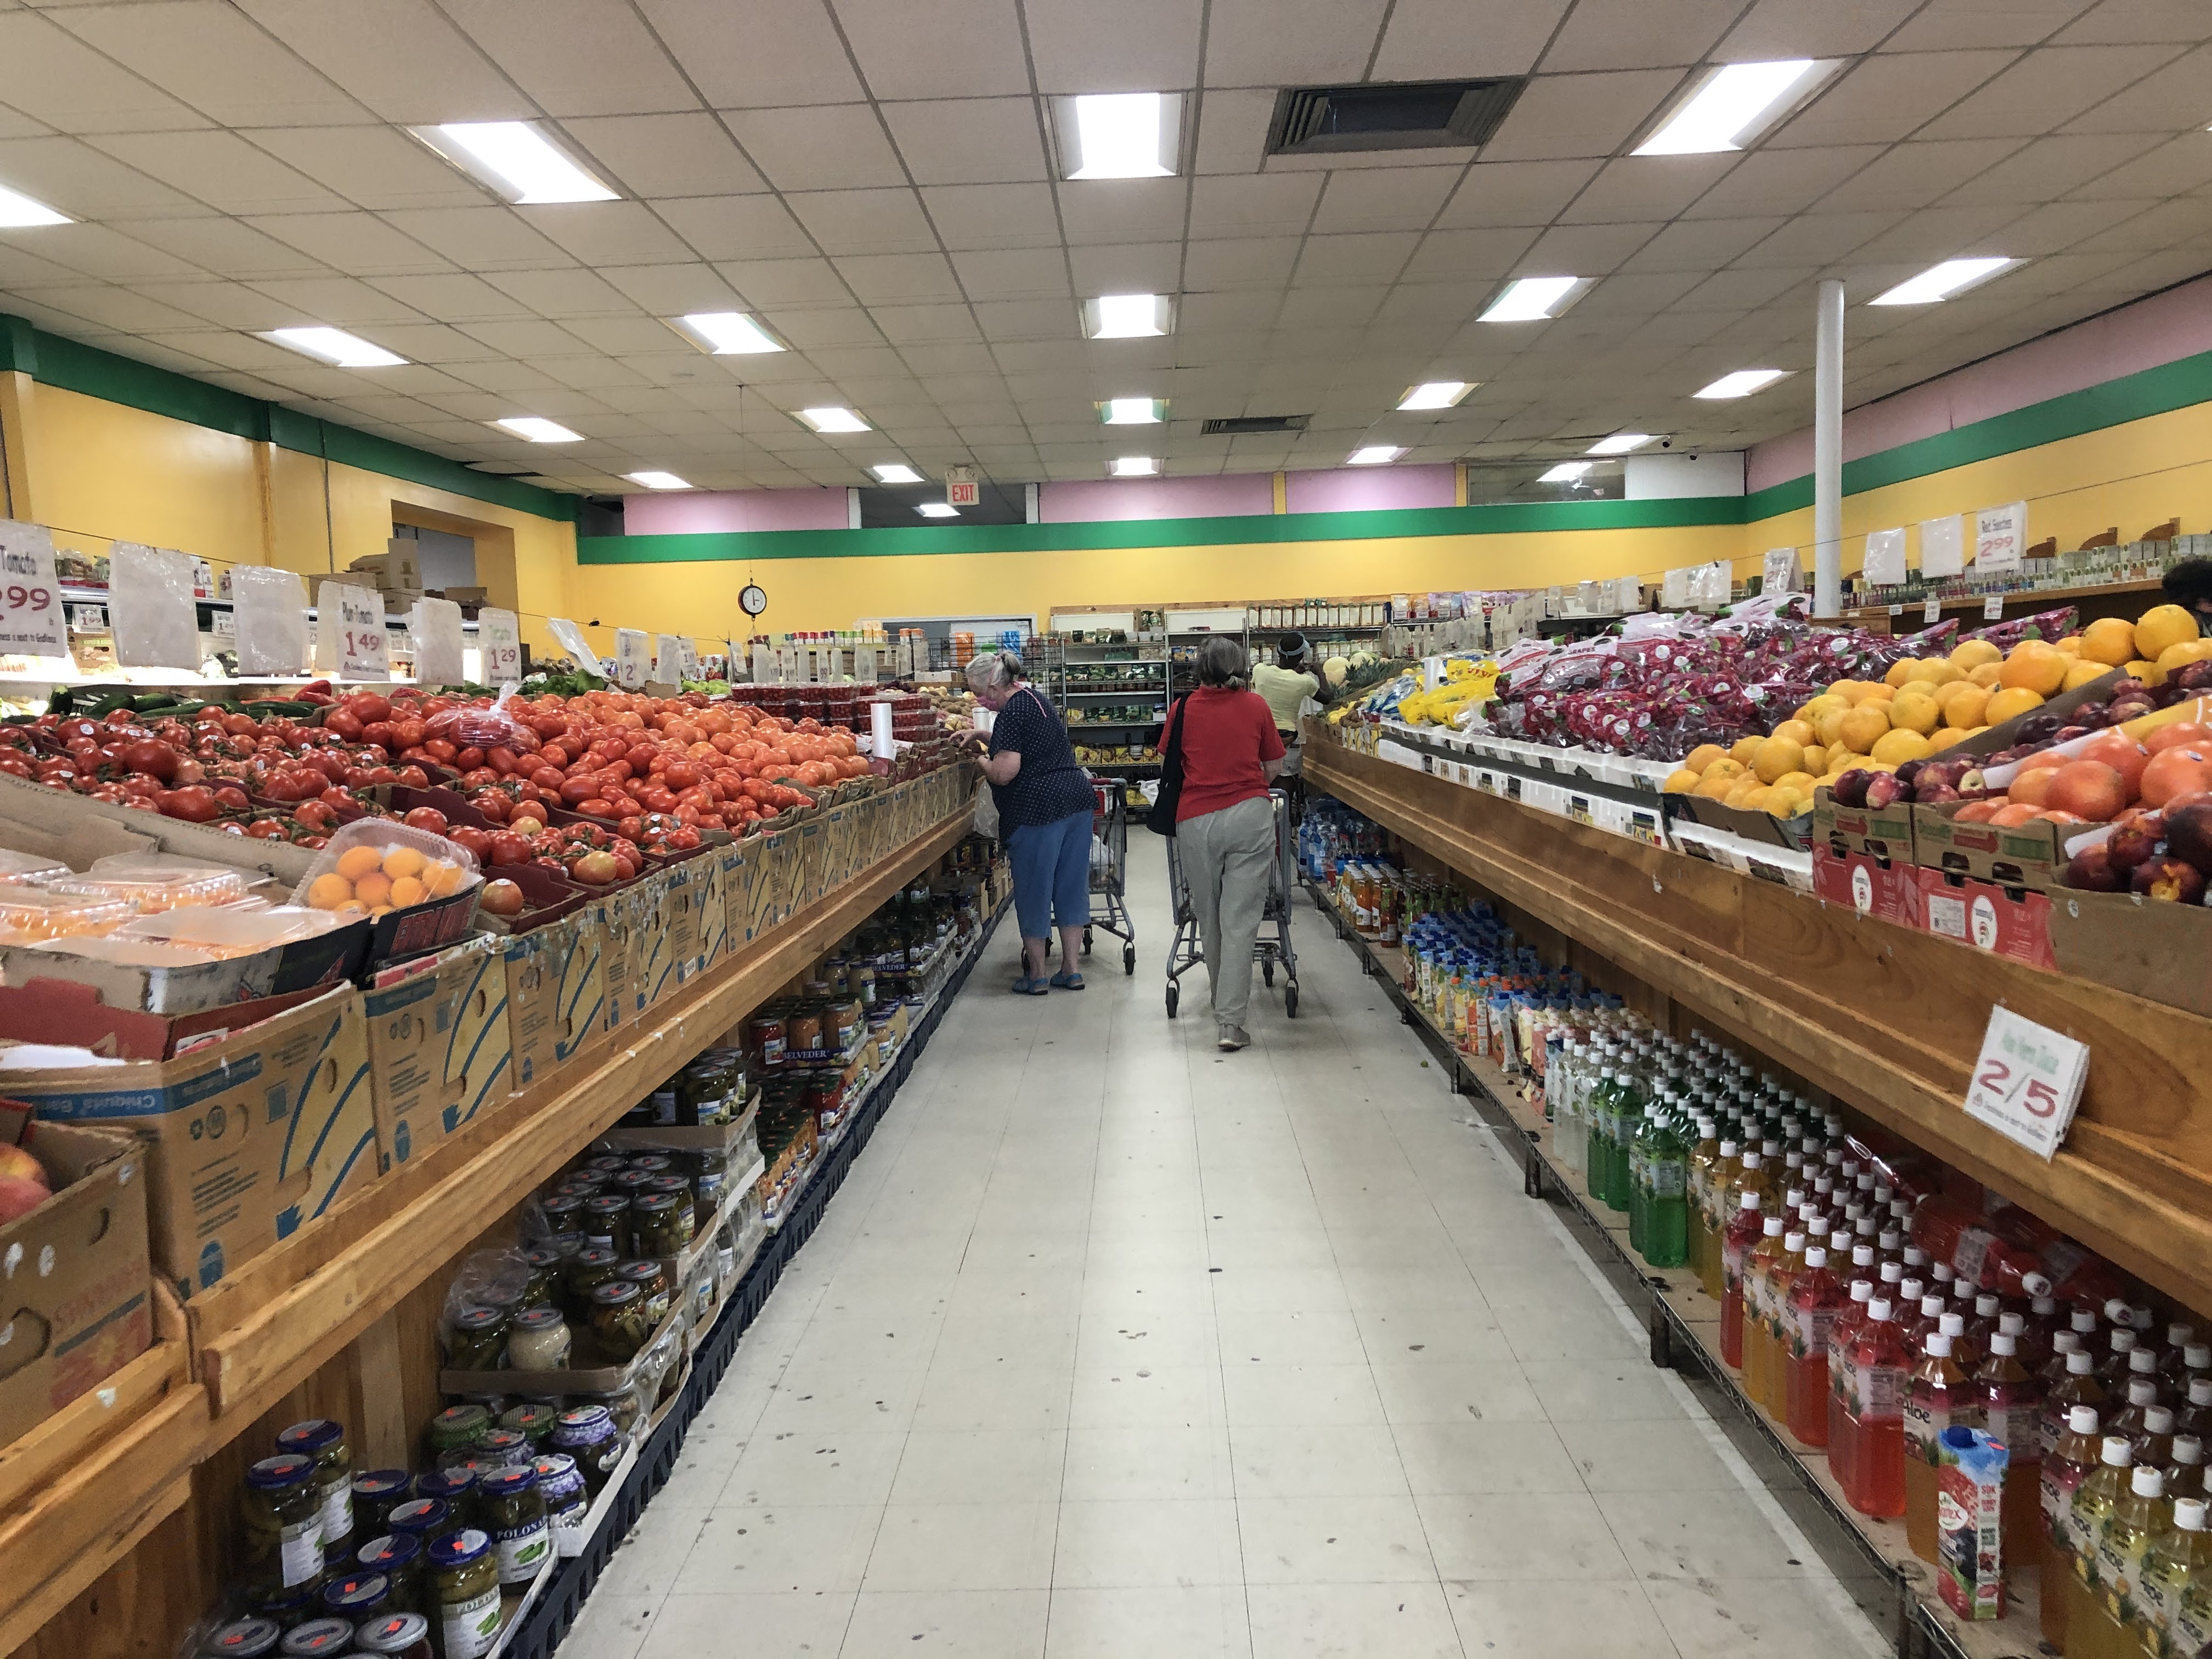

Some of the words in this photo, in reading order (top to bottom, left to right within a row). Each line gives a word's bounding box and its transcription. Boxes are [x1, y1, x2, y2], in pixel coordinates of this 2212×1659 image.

[952, 484, 974, 502] EXIT
[1980, 536, 2014, 557] 299
[0, 585, 51, 621] 99
[345, 631, 380, 657] 149
[1568, 647, 1596, 655] GRAPES
[492, 649, 516, 670] 129
[1978, 1058, 2059, 1118] 2/5
